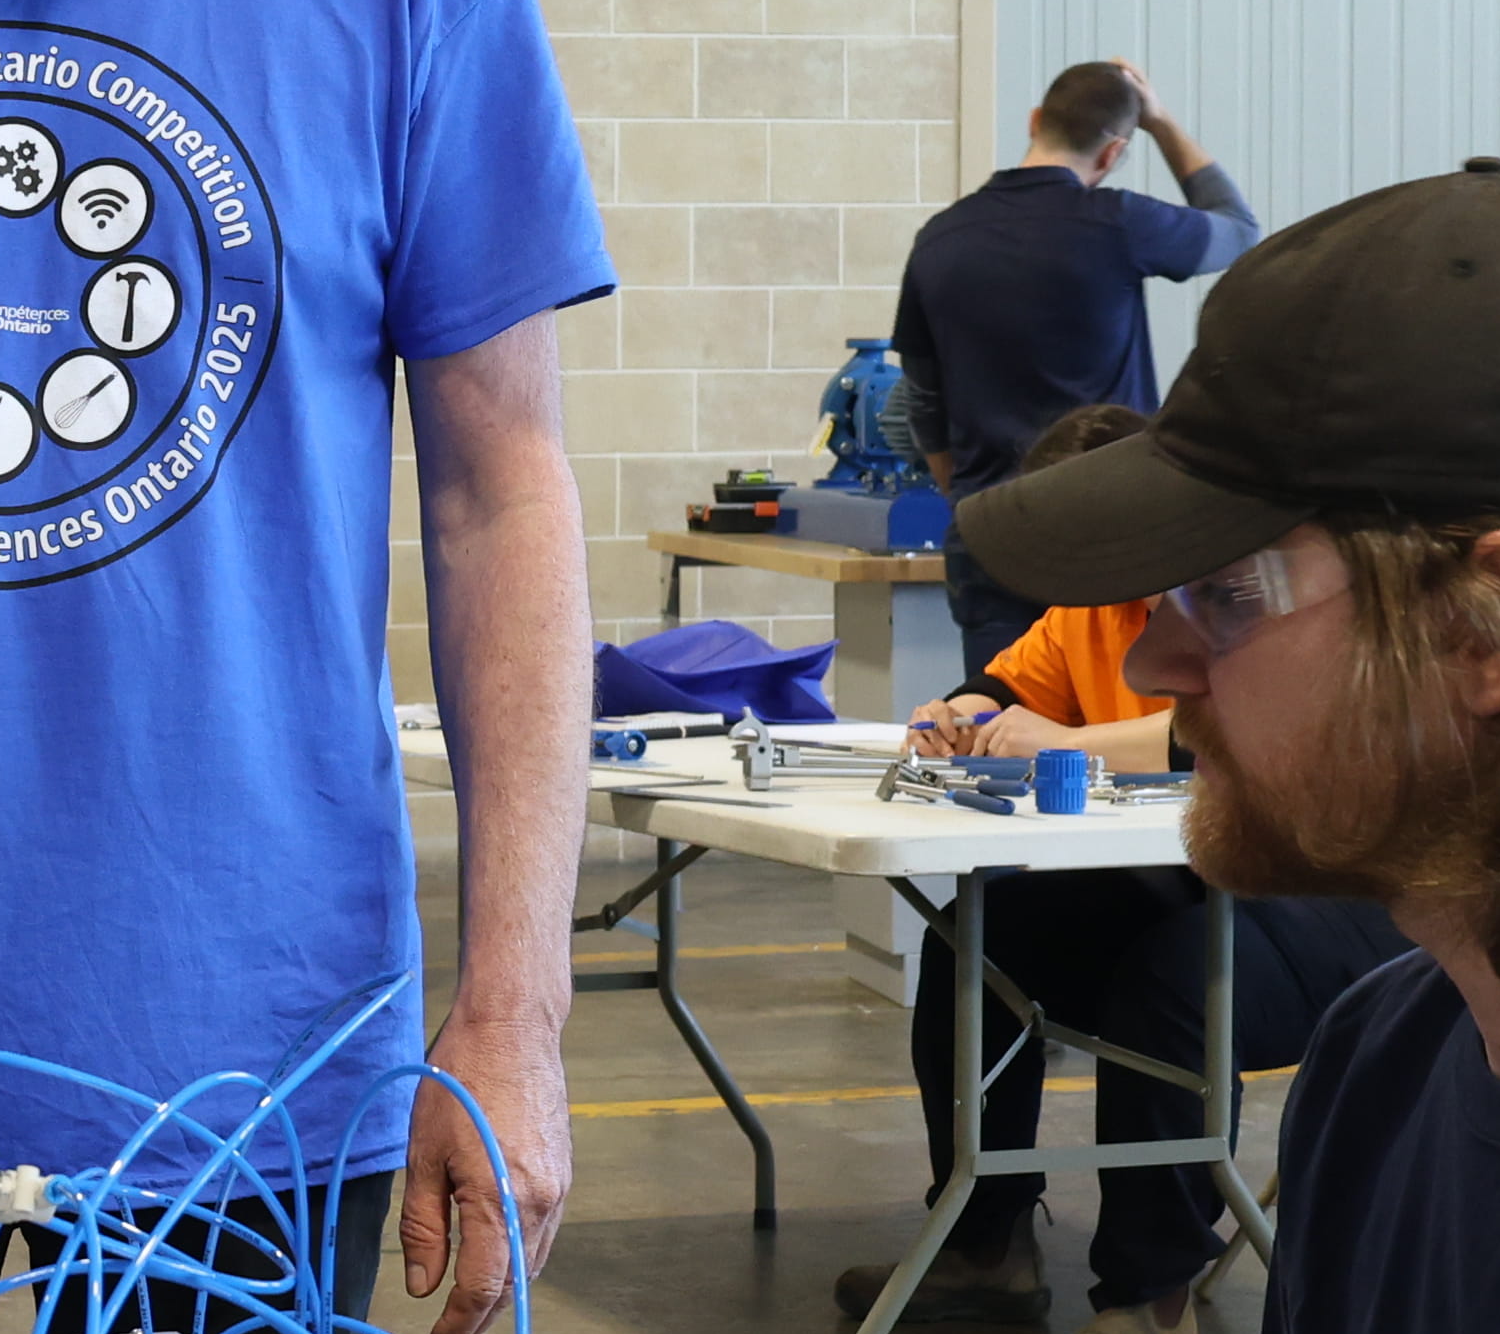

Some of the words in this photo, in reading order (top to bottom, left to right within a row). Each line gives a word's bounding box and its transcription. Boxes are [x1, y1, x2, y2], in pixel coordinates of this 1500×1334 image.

[87, 60, 253, 250] Competition
[104, 404, 217, 526] Ontario
[199, 301, 258, 402] 2025
